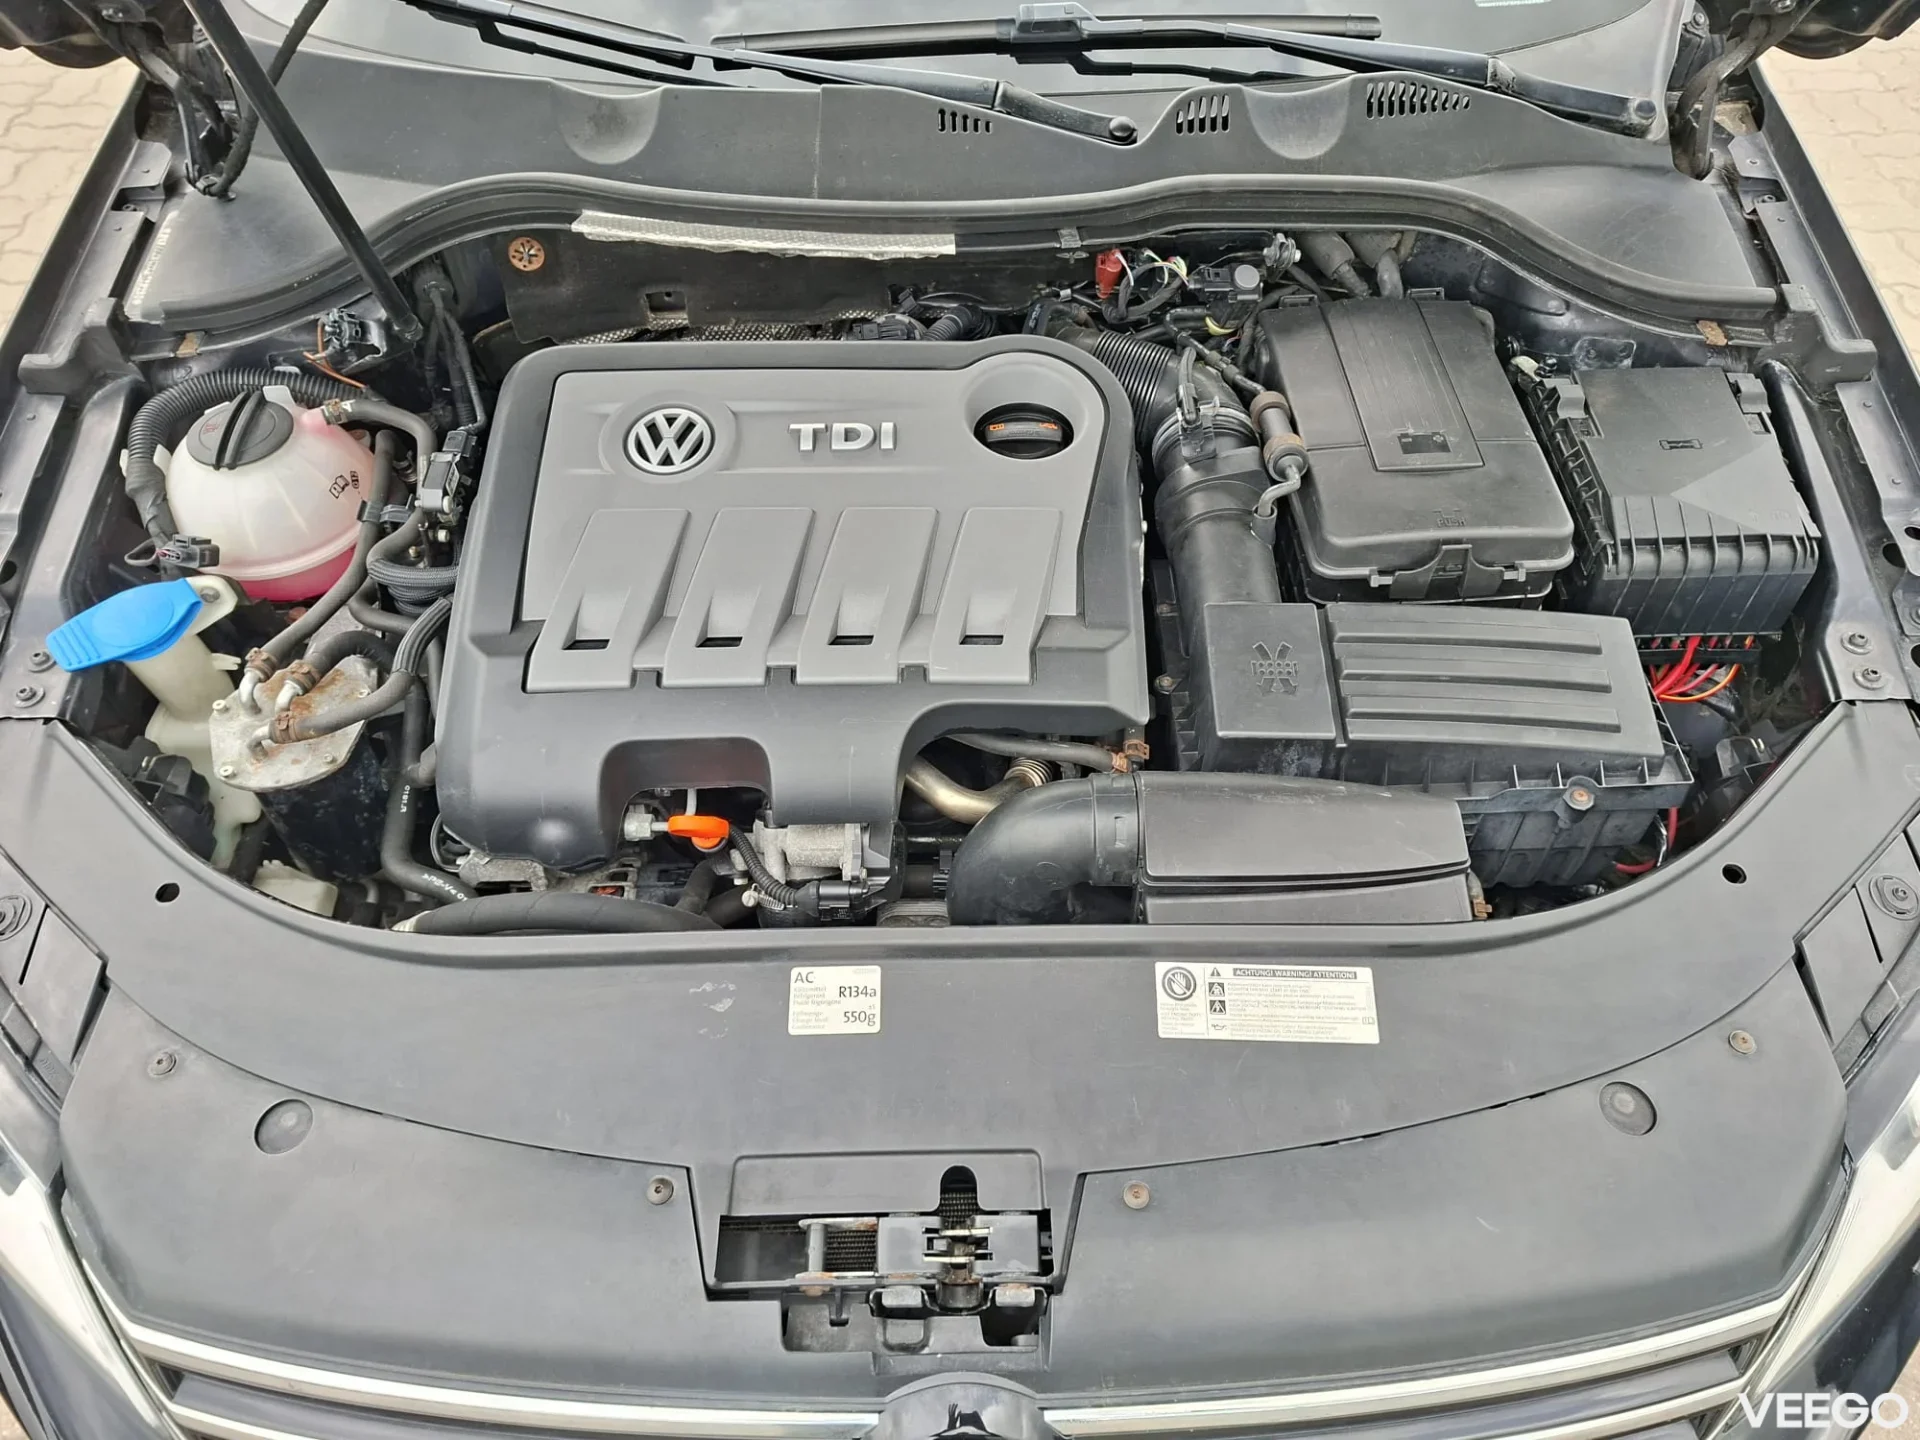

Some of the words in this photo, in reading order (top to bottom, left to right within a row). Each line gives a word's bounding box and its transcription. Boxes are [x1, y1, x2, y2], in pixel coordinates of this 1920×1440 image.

[788, 421, 895, 451] TDI
[794, 971, 815, 984] AC
[1235, 968, 1273, 976] ACHTUNG!
[1274, 969, 1312, 978] WARNING!
[1313, 971, 1355, 979] ATTENTION!
[839, 985, 877, 998] R134a
[843, 1010, 876, 1027] 550g
